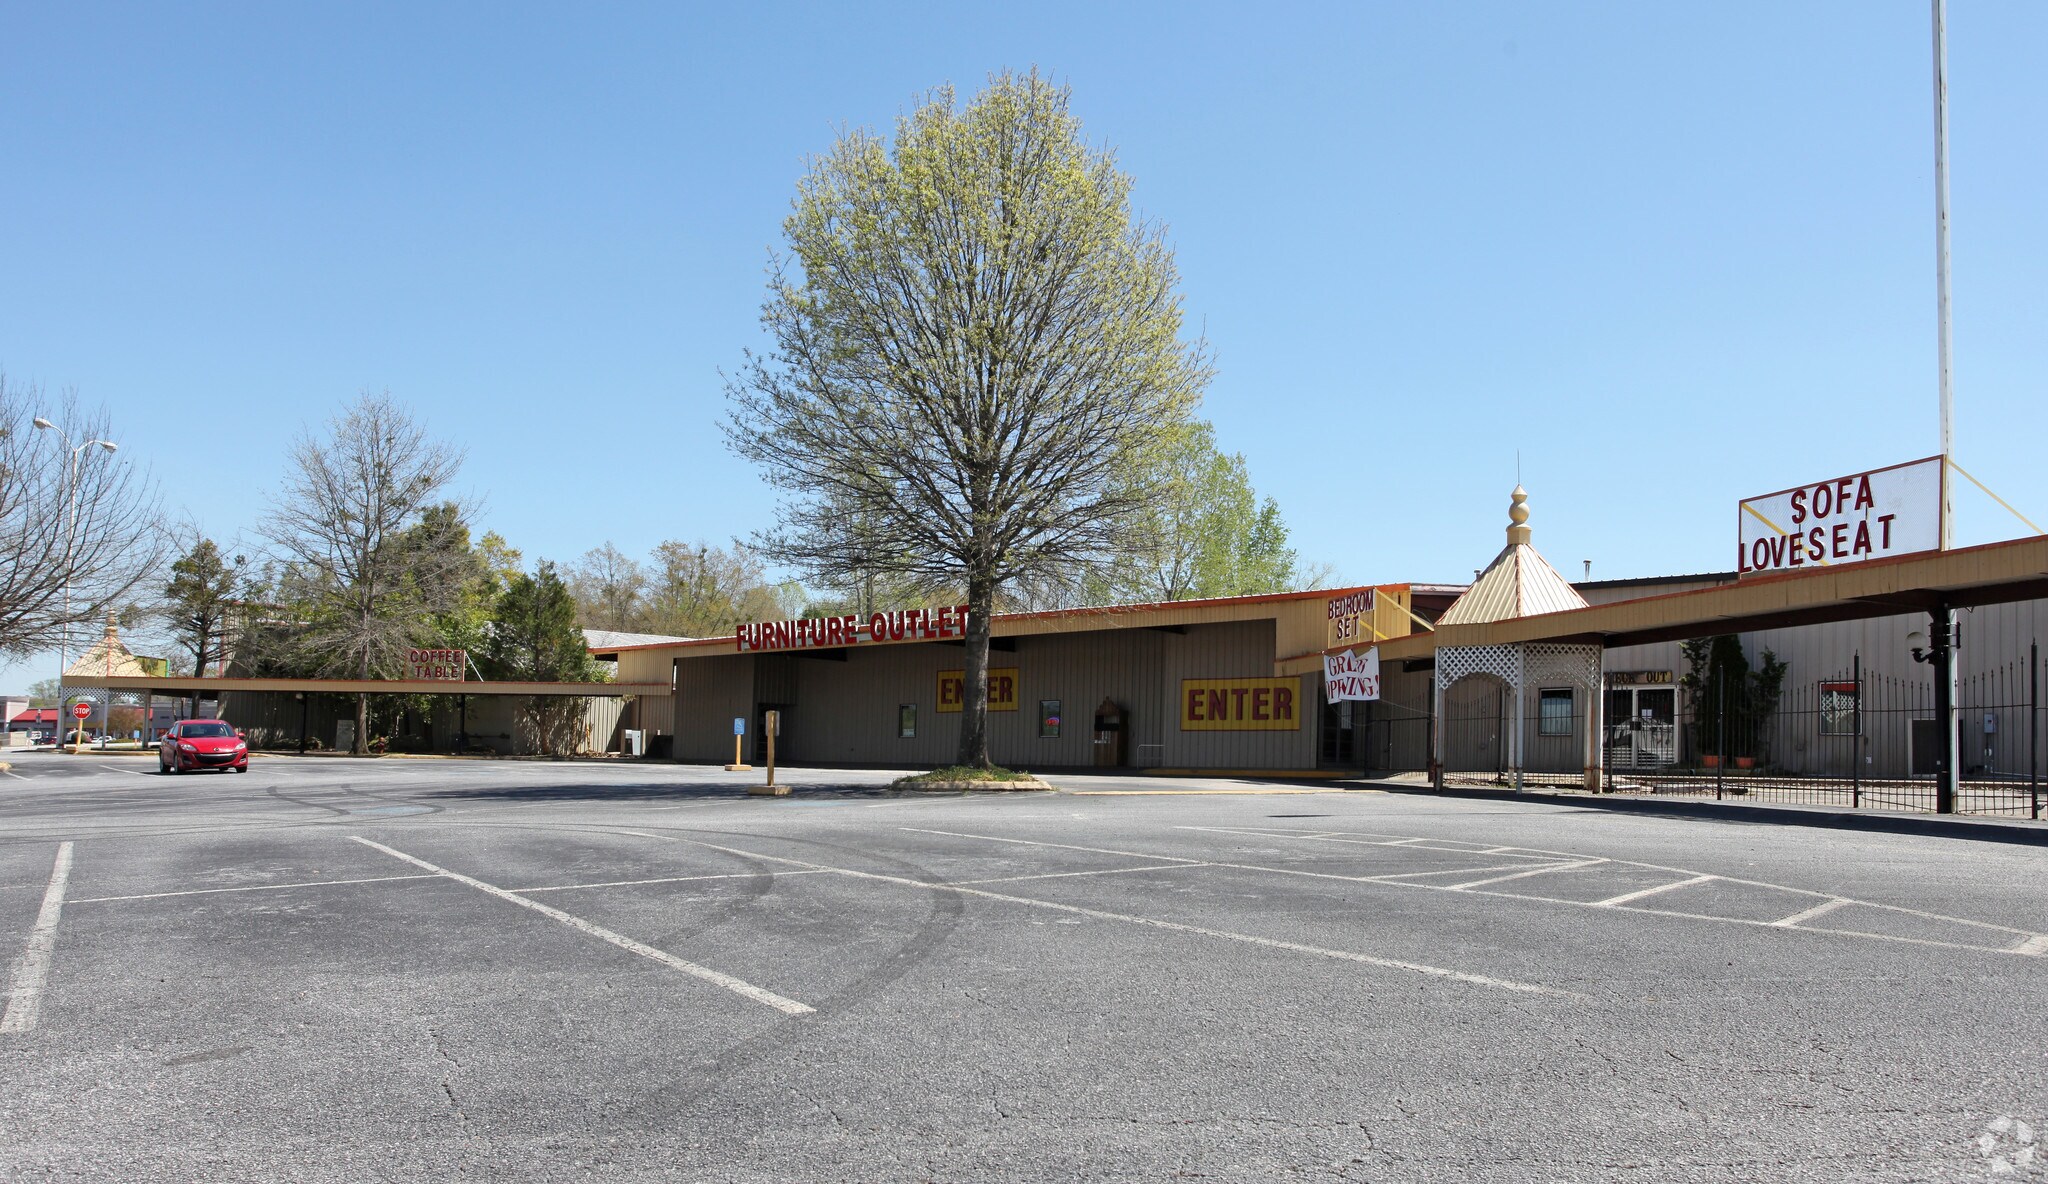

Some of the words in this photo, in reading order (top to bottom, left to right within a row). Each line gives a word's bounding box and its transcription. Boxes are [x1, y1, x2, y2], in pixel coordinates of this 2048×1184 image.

[1791, 475, 1874, 524] SOFA
[1740, 514, 1895, 573] LOVESEAT
[1328, 589, 1373, 620] BEDROOM
[737, 615, 858, 651] FURNITURE
[870, 605, 969, 642] OUTLET
[1337, 615, 1359, 639] SET
[410, 650, 461, 662] COFFEE
[415, 666, 458, 677] TABLE
[1647, 671, 1667, 684] OUT
[941, 676, 1013, 704] ENER
[1188, 687, 1292, 720] ENTER
